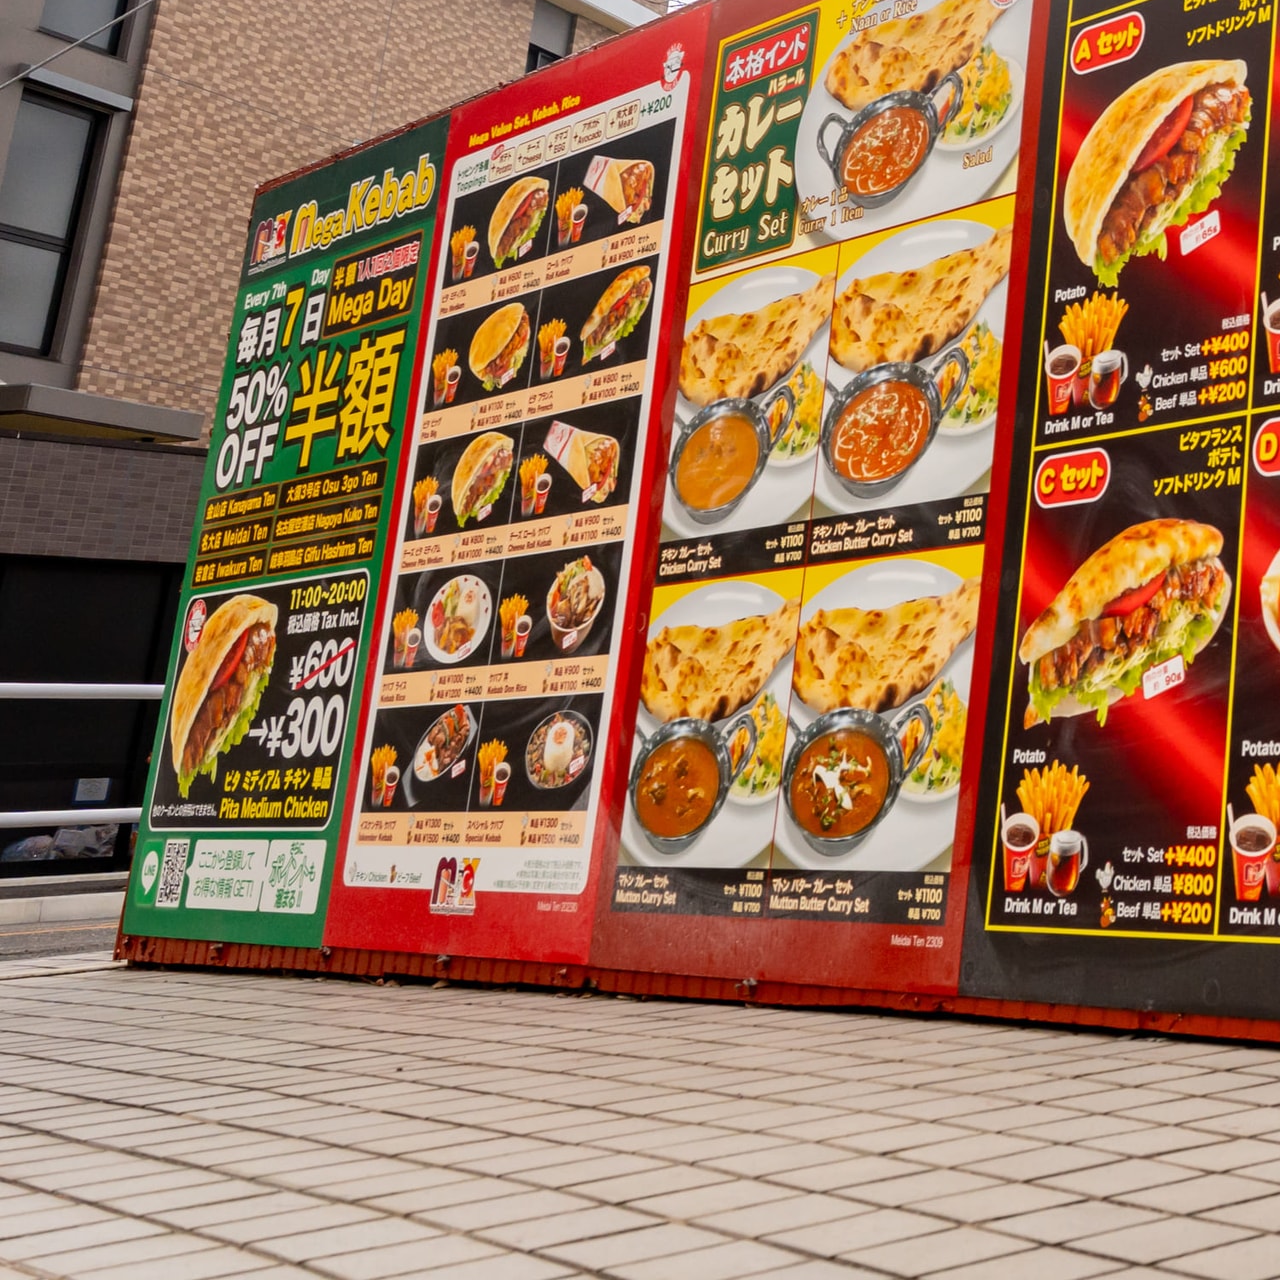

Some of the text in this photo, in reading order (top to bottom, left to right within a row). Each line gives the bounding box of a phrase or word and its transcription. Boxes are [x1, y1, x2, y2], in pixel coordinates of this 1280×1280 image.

[850, 13, 878, 34] Naan
[880, 8, 891, 21] or
[725, 23, 808, 85] 本格インド
[1075, 22, 1140, 62] A セット
[768, 68, 806, 97] ハラール
[561, 95, 581, 112] Rice
[714, 91, 804, 162] カレー
[962, 146, 993, 169] Salad
[711, 146, 794, 220] セット
[703, 210, 789, 258] Curry Set
[244, 268, 331, 310] Every 7th Day
[327, 277, 414, 327] Mega Day
[1054, 283, 1087, 303] Potato
[1152, 355, 1248, 388] Chicken 単品 ¥600
[226, 361, 290, 431] 50%
[283, 329, 405, 468] 半額
[1179, 425, 1242, 451] ピタフランス
[1259, 433, 1278, 460] D
[215, 423, 280, 489] OFF
[1039, 462, 1105, 495] C セット
[263, 491, 276, 506] Ten
[201, 524, 268, 551] 名大店 Meidai Ten
[811, 529, 913, 555] Chicken Butter Curry Set
[660, 556, 722, 576] Chicken Curry Set
[321, 611, 338, 629] Tax
[339, 607, 359, 627] Incl.
[289, 637, 356, 690] ¥600
[265, 694, 344, 759] ¥300
[1012, 746, 1046, 764] Potato
[219, 796, 328, 819] Pita Medium Chicken
[615, 890, 676, 906] Mutton Curry Set
[1113, 874, 1214, 896] Chicken 単品 ¥800
[769, 895, 870, 914] Mutton Butter Curry Set
[1229, 906, 1268, 926] Drink
[1266, 907, 1280, 926] M
[913, 936, 925, 946] Ten
